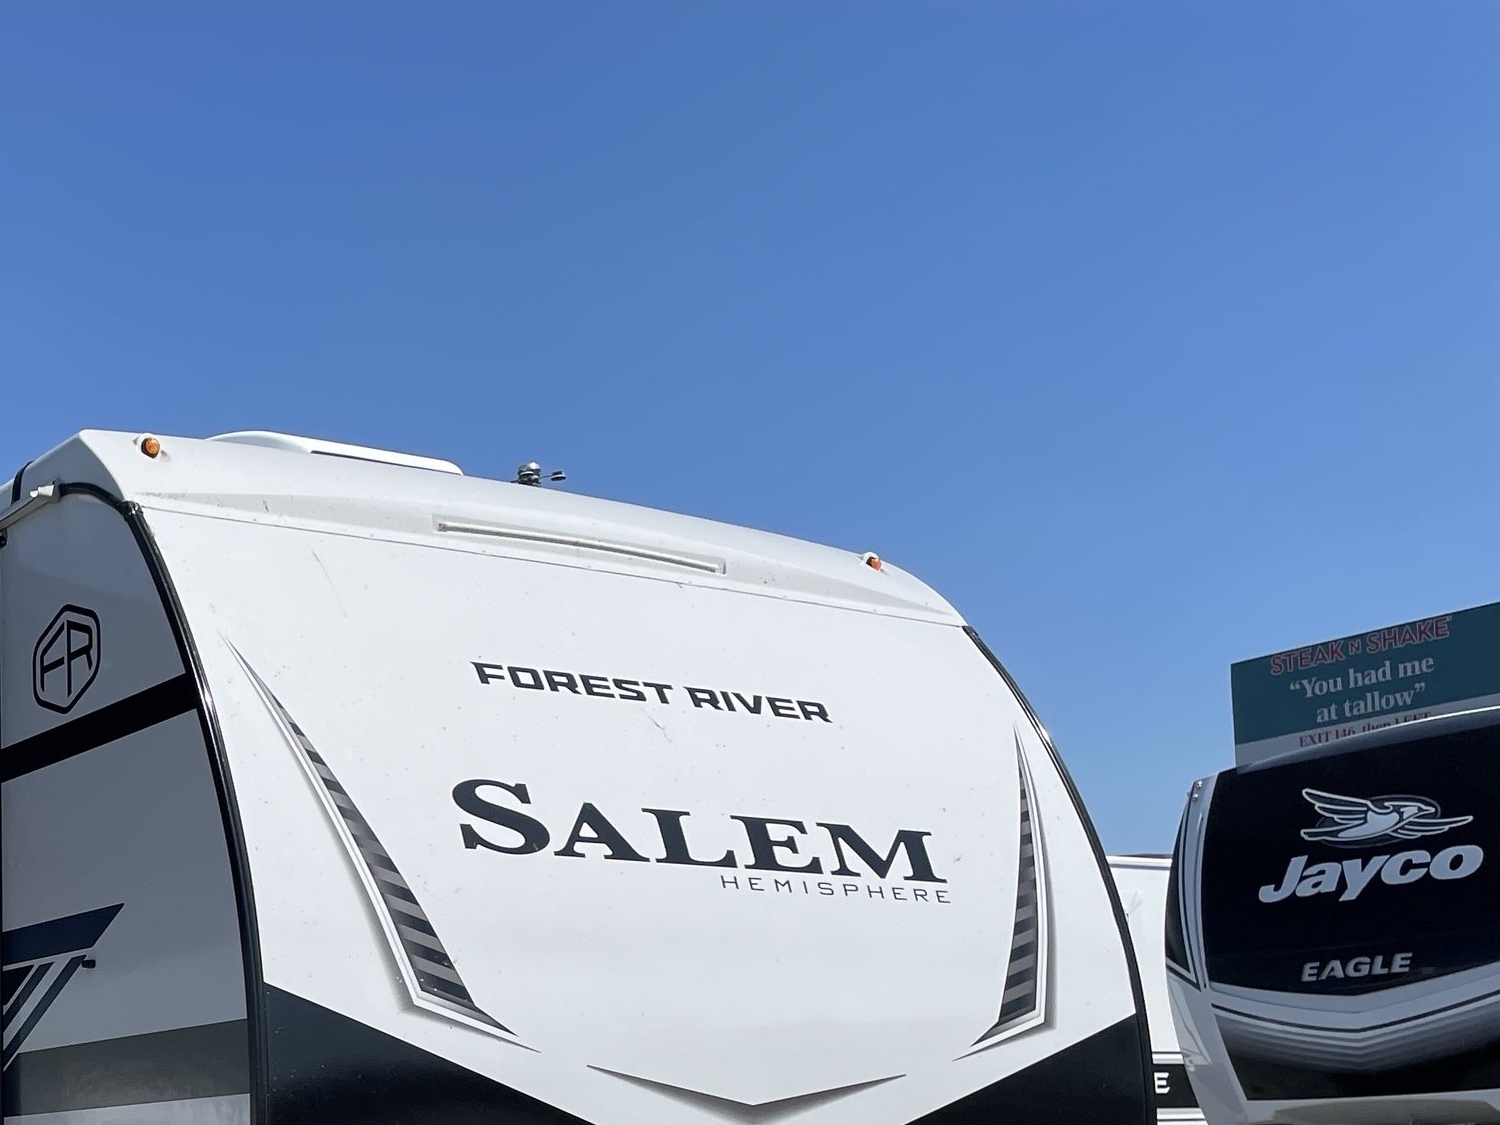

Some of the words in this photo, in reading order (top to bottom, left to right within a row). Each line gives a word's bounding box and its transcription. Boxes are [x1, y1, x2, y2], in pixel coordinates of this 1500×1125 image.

[1270, 639, 1346, 676] STEAK
[1366, 616, 1451, 654] SHAKE
[1349, 660, 1391, 689] had
[1398, 656, 1434, 678] me
[470, 661, 673, 704] FOREST
[683, 686, 834, 723] RIVER
[1316, 701, 1338, 723] at
[1300, 730, 1334, 747] EXIT
[451, 778, 948, 884] SALEM
[720, 874, 952, 904] HEMISPHERE
[1258, 845, 1484, 903] Jayco
[1301, 952, 1413, 983] EAGLE
